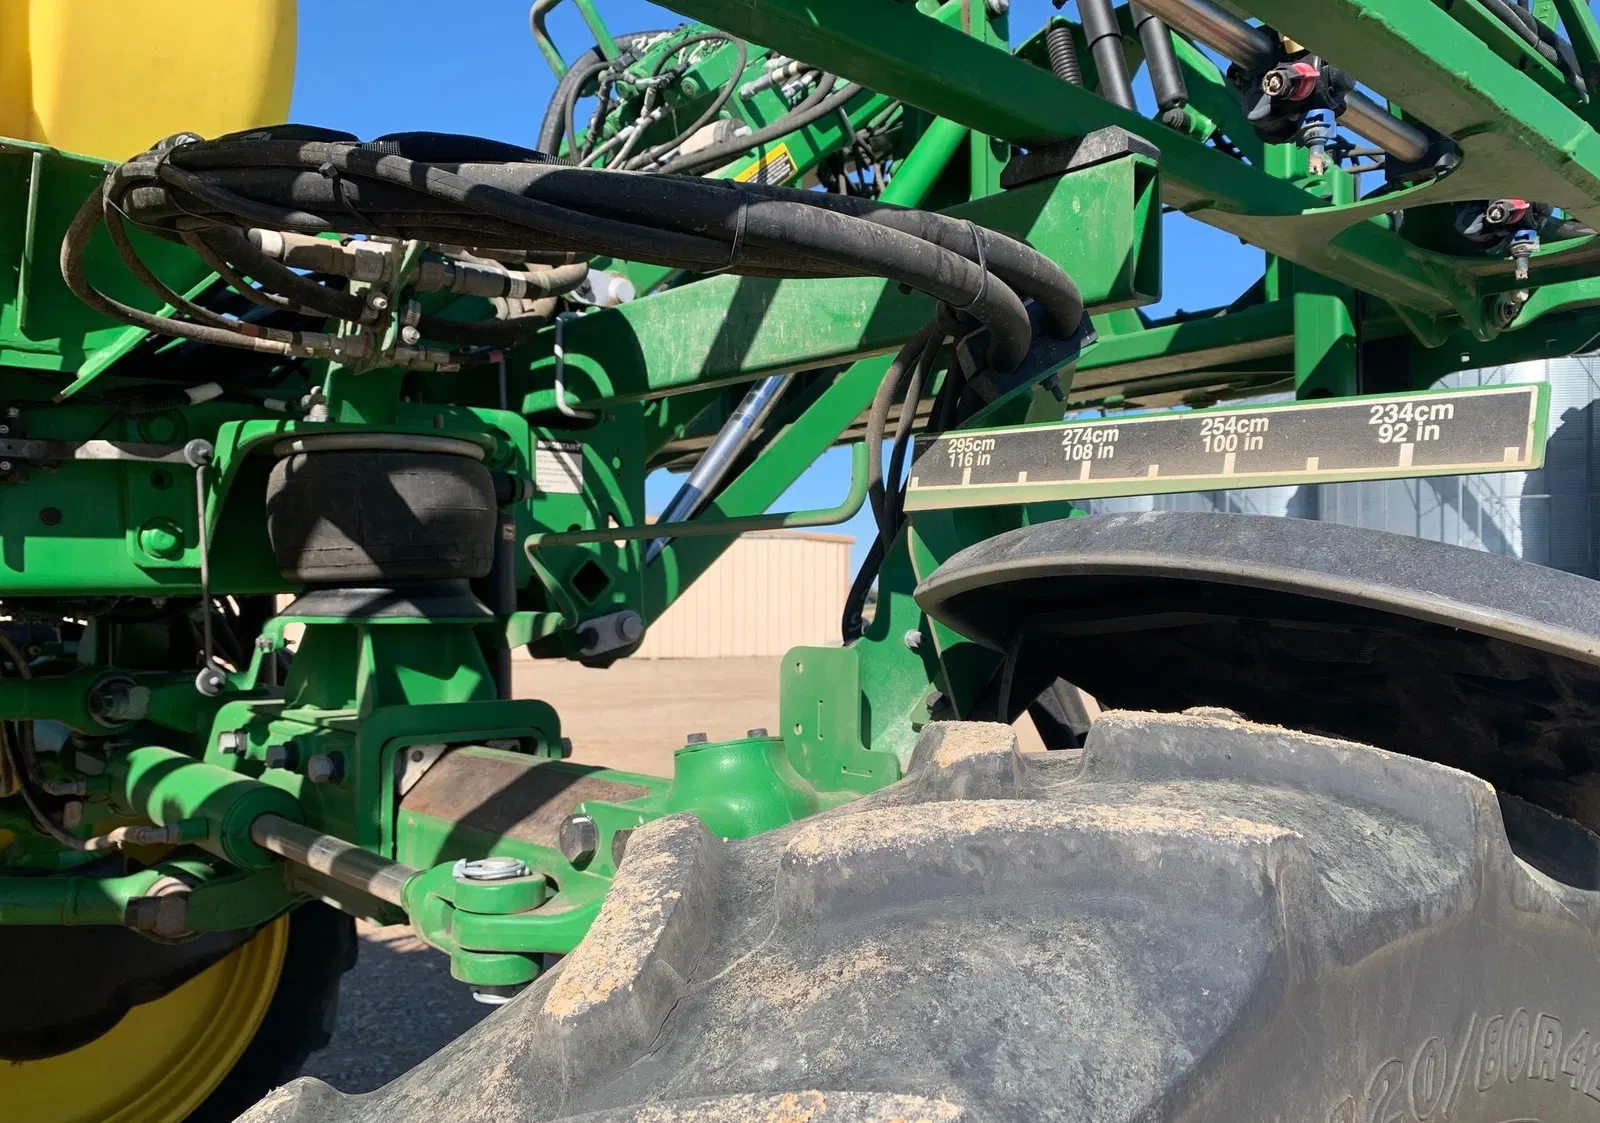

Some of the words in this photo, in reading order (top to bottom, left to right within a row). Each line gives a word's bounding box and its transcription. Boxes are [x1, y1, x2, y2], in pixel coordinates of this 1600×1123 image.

[1369, 403, 1454, 424] 234cm
[1200, 416, 1269, 436] 254cm
[1378, 422, 1408, 443] 92
[1415, 420, 1440, 441] in
[947, 437, 996, 454] 295cm
[1062, 427, 1119, 446] 274cm
[1202, 433, 1238, 453] 100
[1244, 432, 1264, 451] in
[949, 452, 973, 468] 116
[976, 451, 991, 466] in
[1063, 444, 1093, 461] 108
[1097, 442, 1114, 459] in
